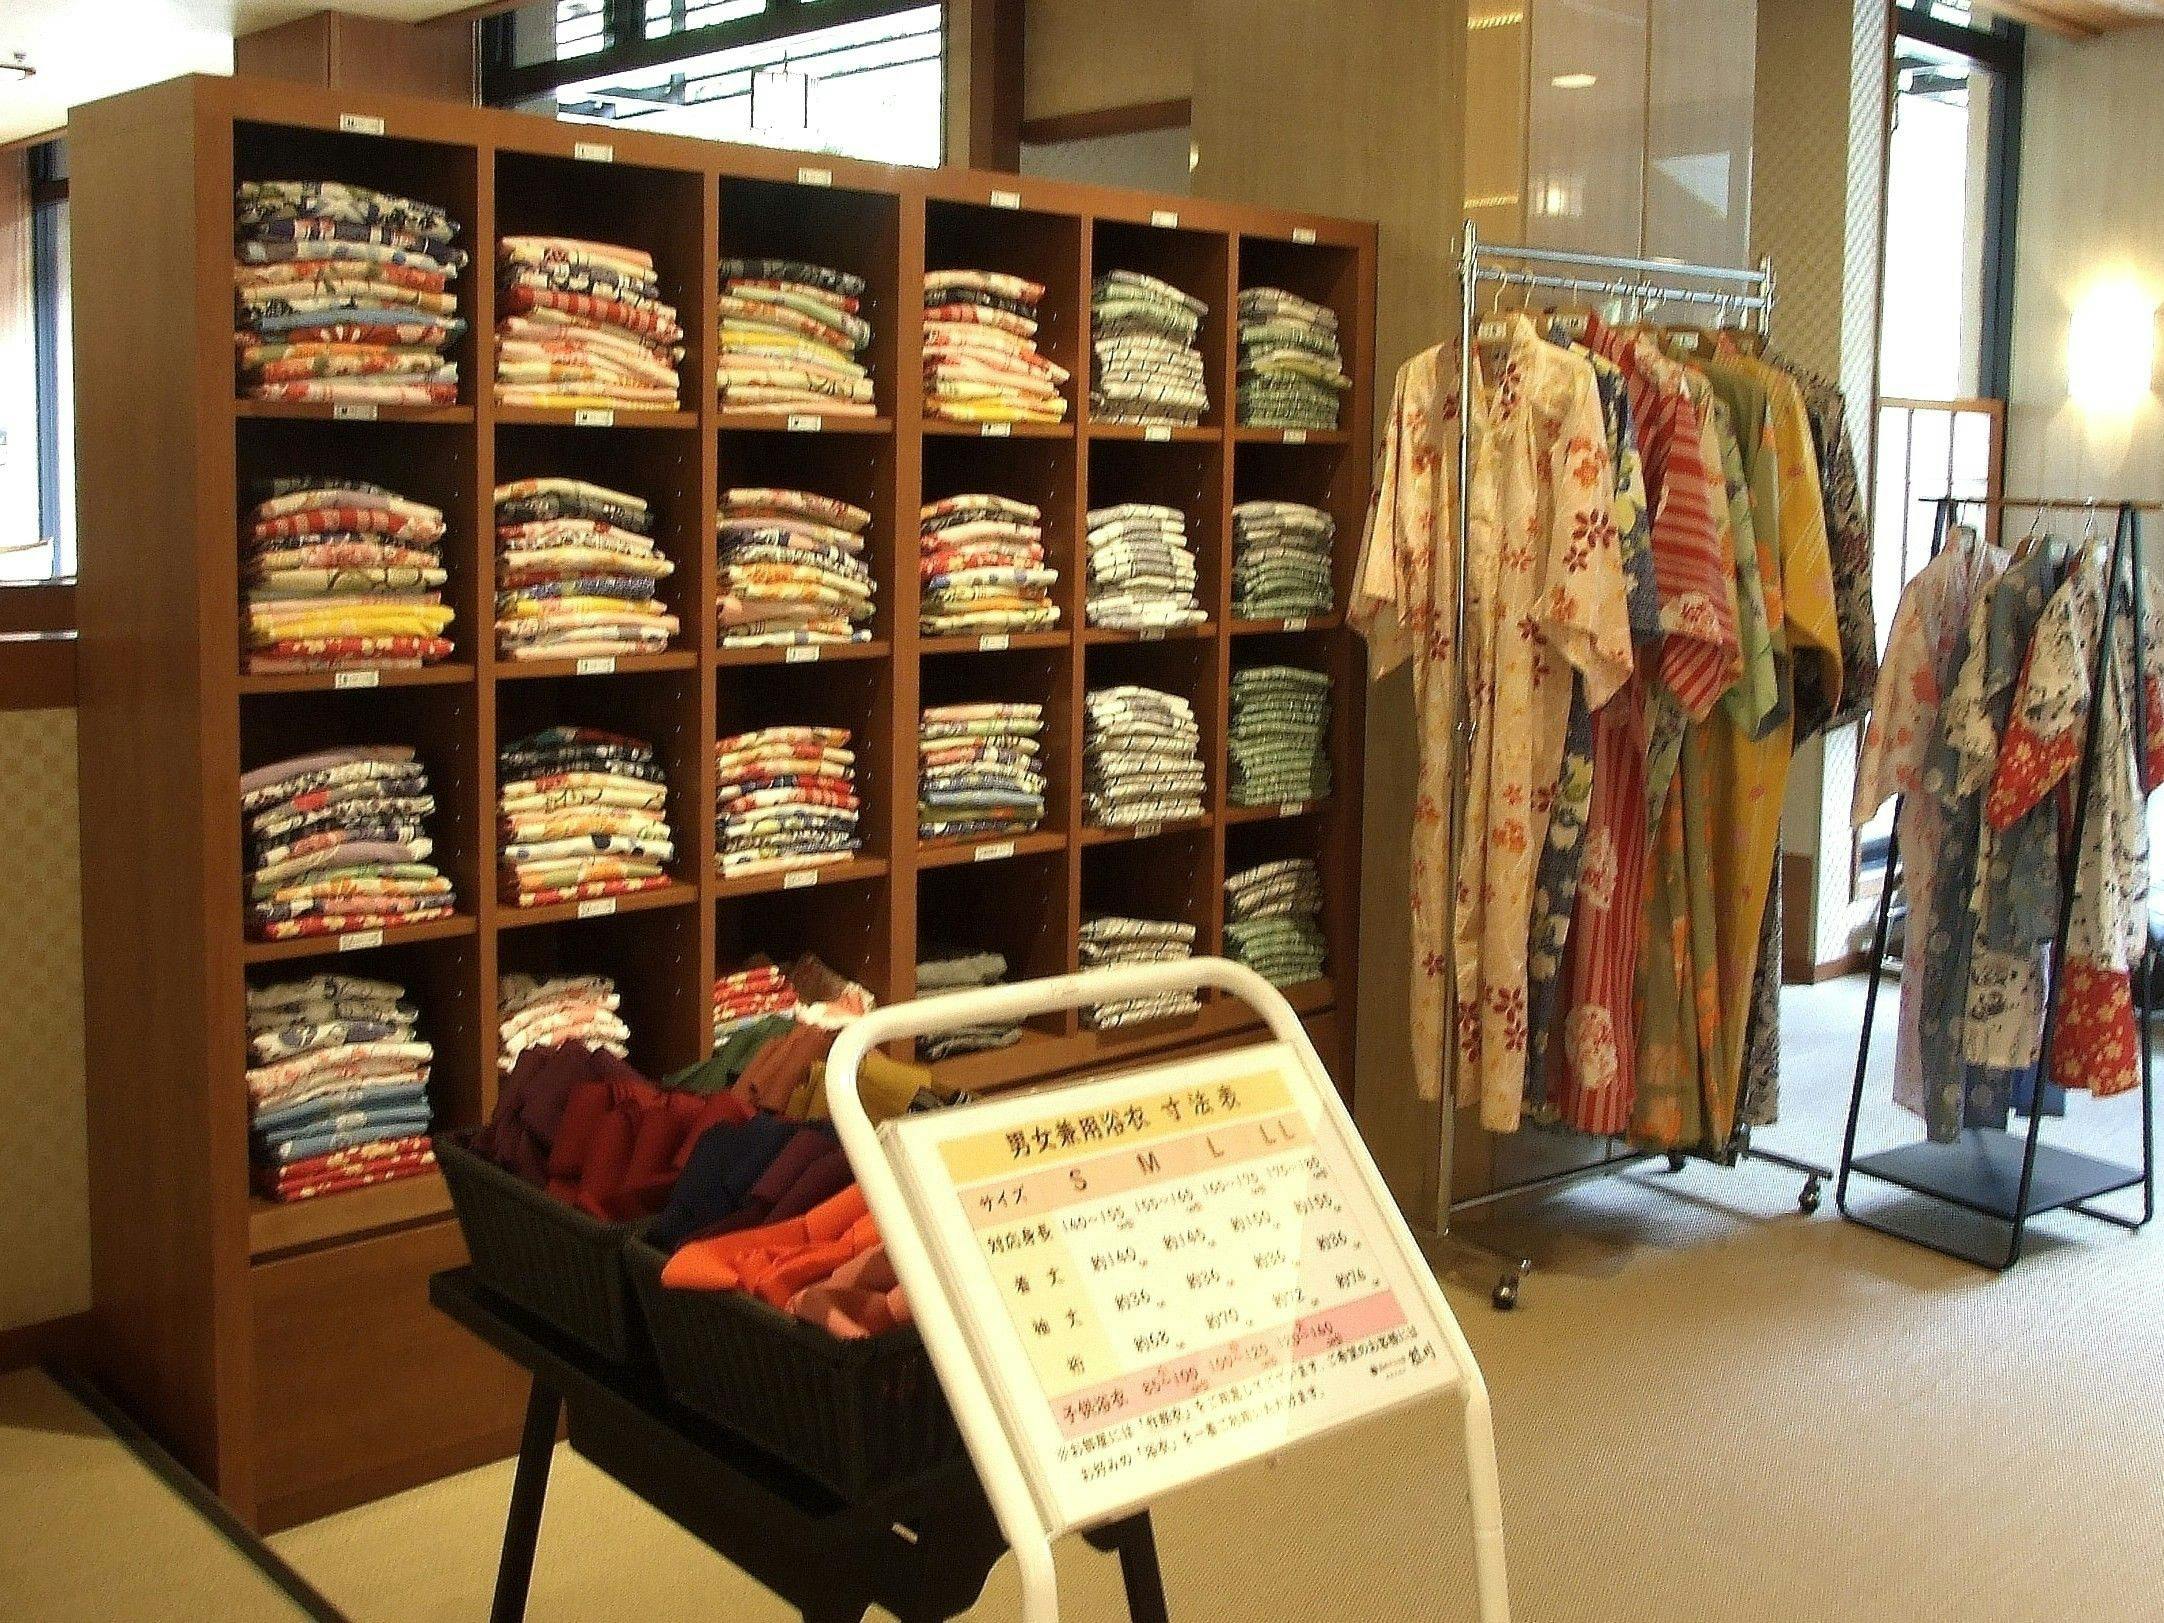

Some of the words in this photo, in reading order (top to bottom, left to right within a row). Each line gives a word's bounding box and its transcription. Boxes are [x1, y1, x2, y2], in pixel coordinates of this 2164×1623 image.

[1005, 1103, 1151, 1160] 男女兼用浴衣
[979, 1184, 1029, 1212] サイズ
[1068, 1168, 1088, 1192] S
[1136, 1151, 1161, 1176] M
[1205, 1136, 1225, 1158] L
